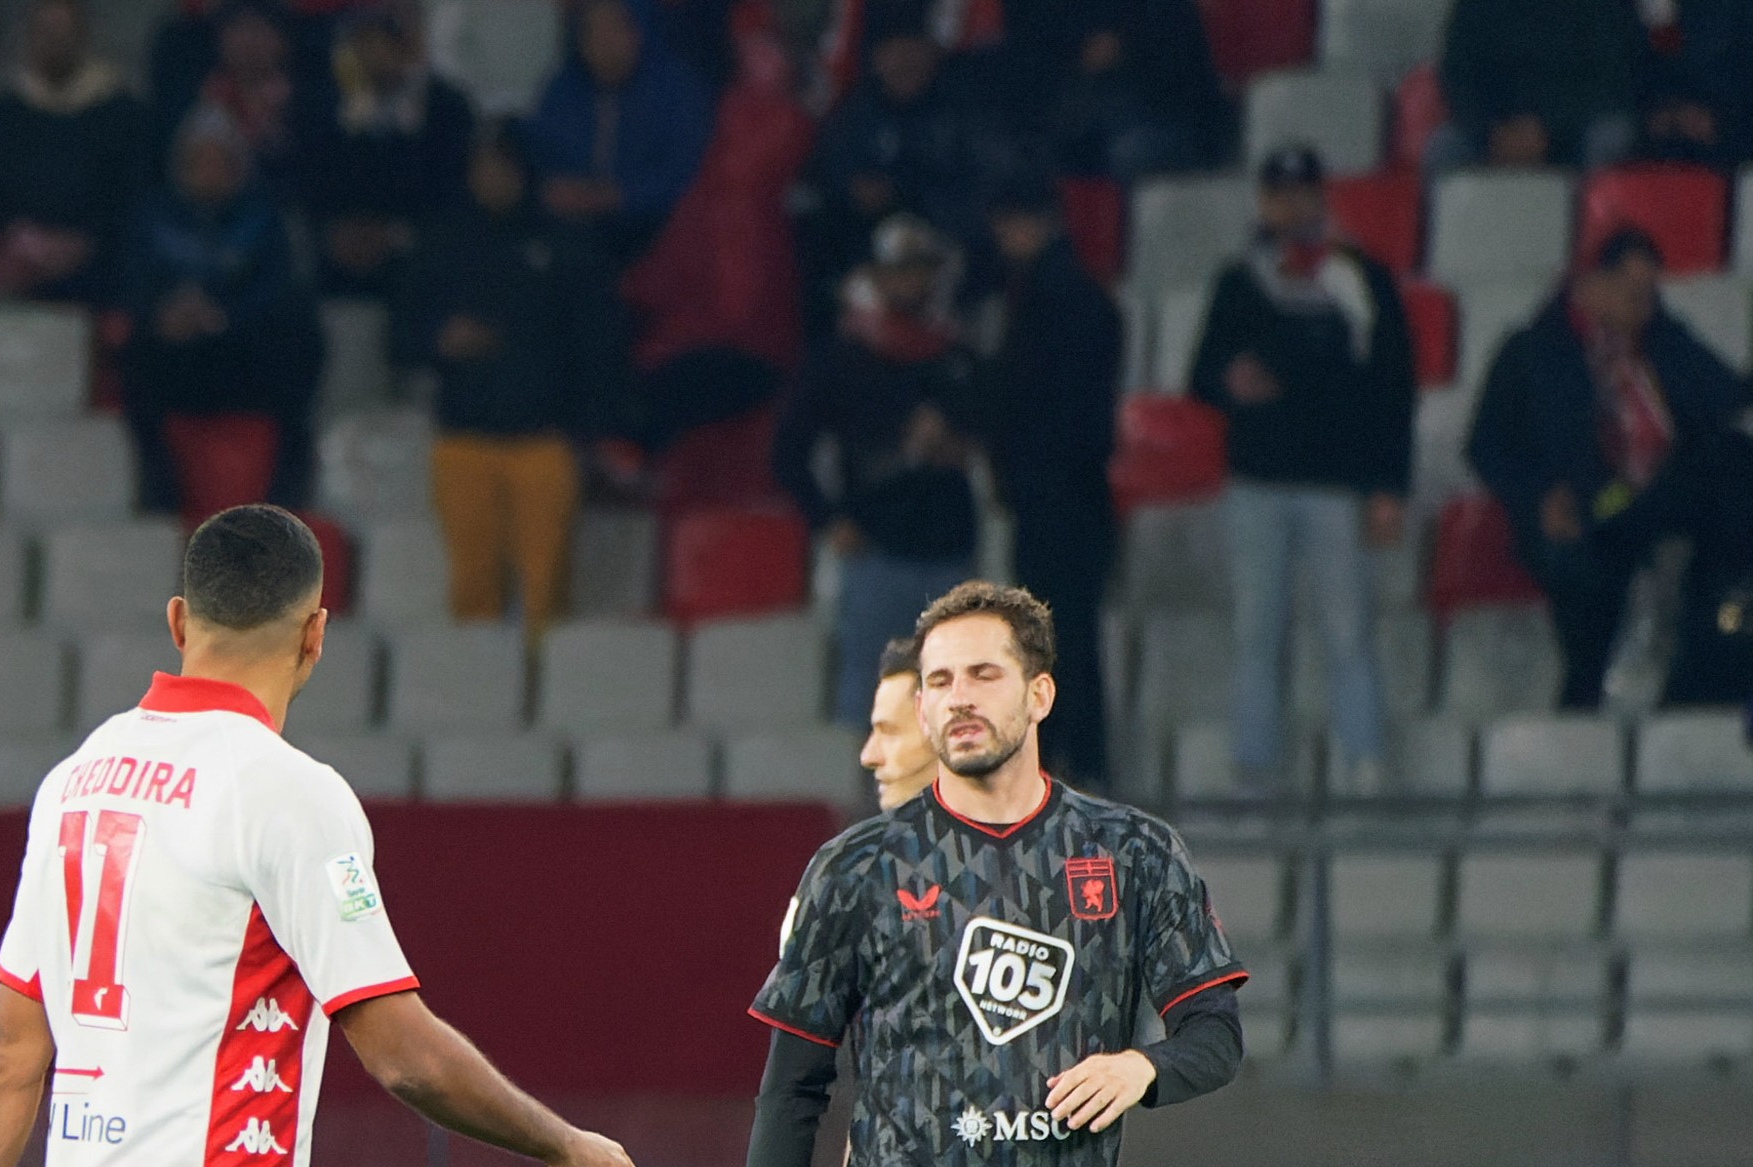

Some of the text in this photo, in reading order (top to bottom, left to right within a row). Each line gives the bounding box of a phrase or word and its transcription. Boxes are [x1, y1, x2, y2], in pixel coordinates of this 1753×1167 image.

[57, 808, 146, 1026] 11
[990, 932, 1050, 961] RADIO
[968, 948, 1057, 1011] 105
[61, 1102, 127, 1145] Line
